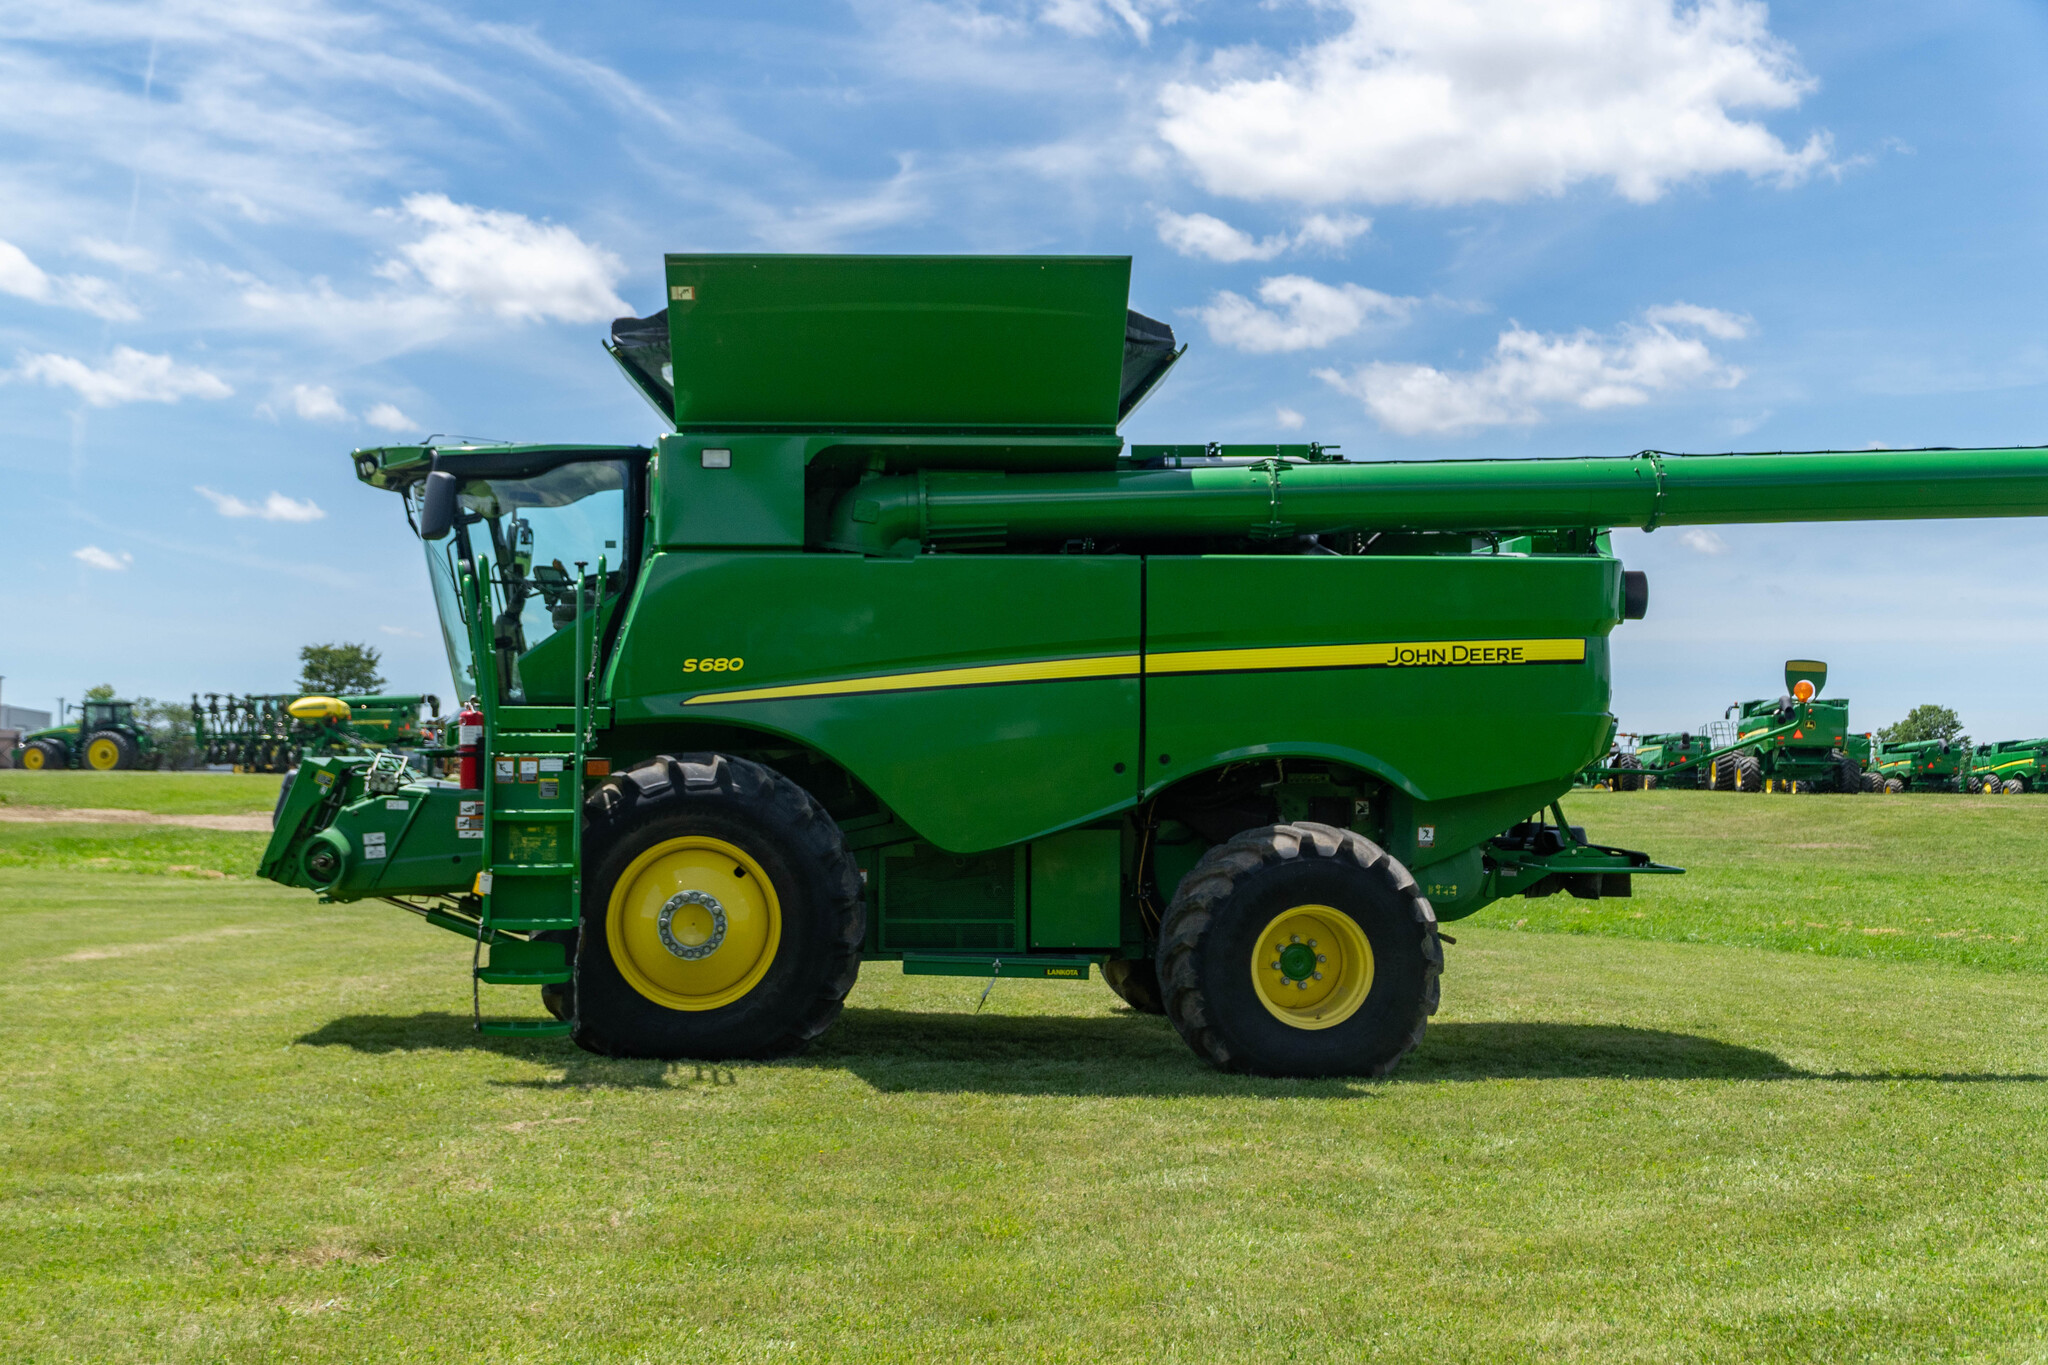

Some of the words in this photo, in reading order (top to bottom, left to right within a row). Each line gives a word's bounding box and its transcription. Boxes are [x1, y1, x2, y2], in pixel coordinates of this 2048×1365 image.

[1387, 647, 1446, 663] JOHN
[1452, 645, 1524, 662] DEERE
[682, 657, 744, 672] S680
